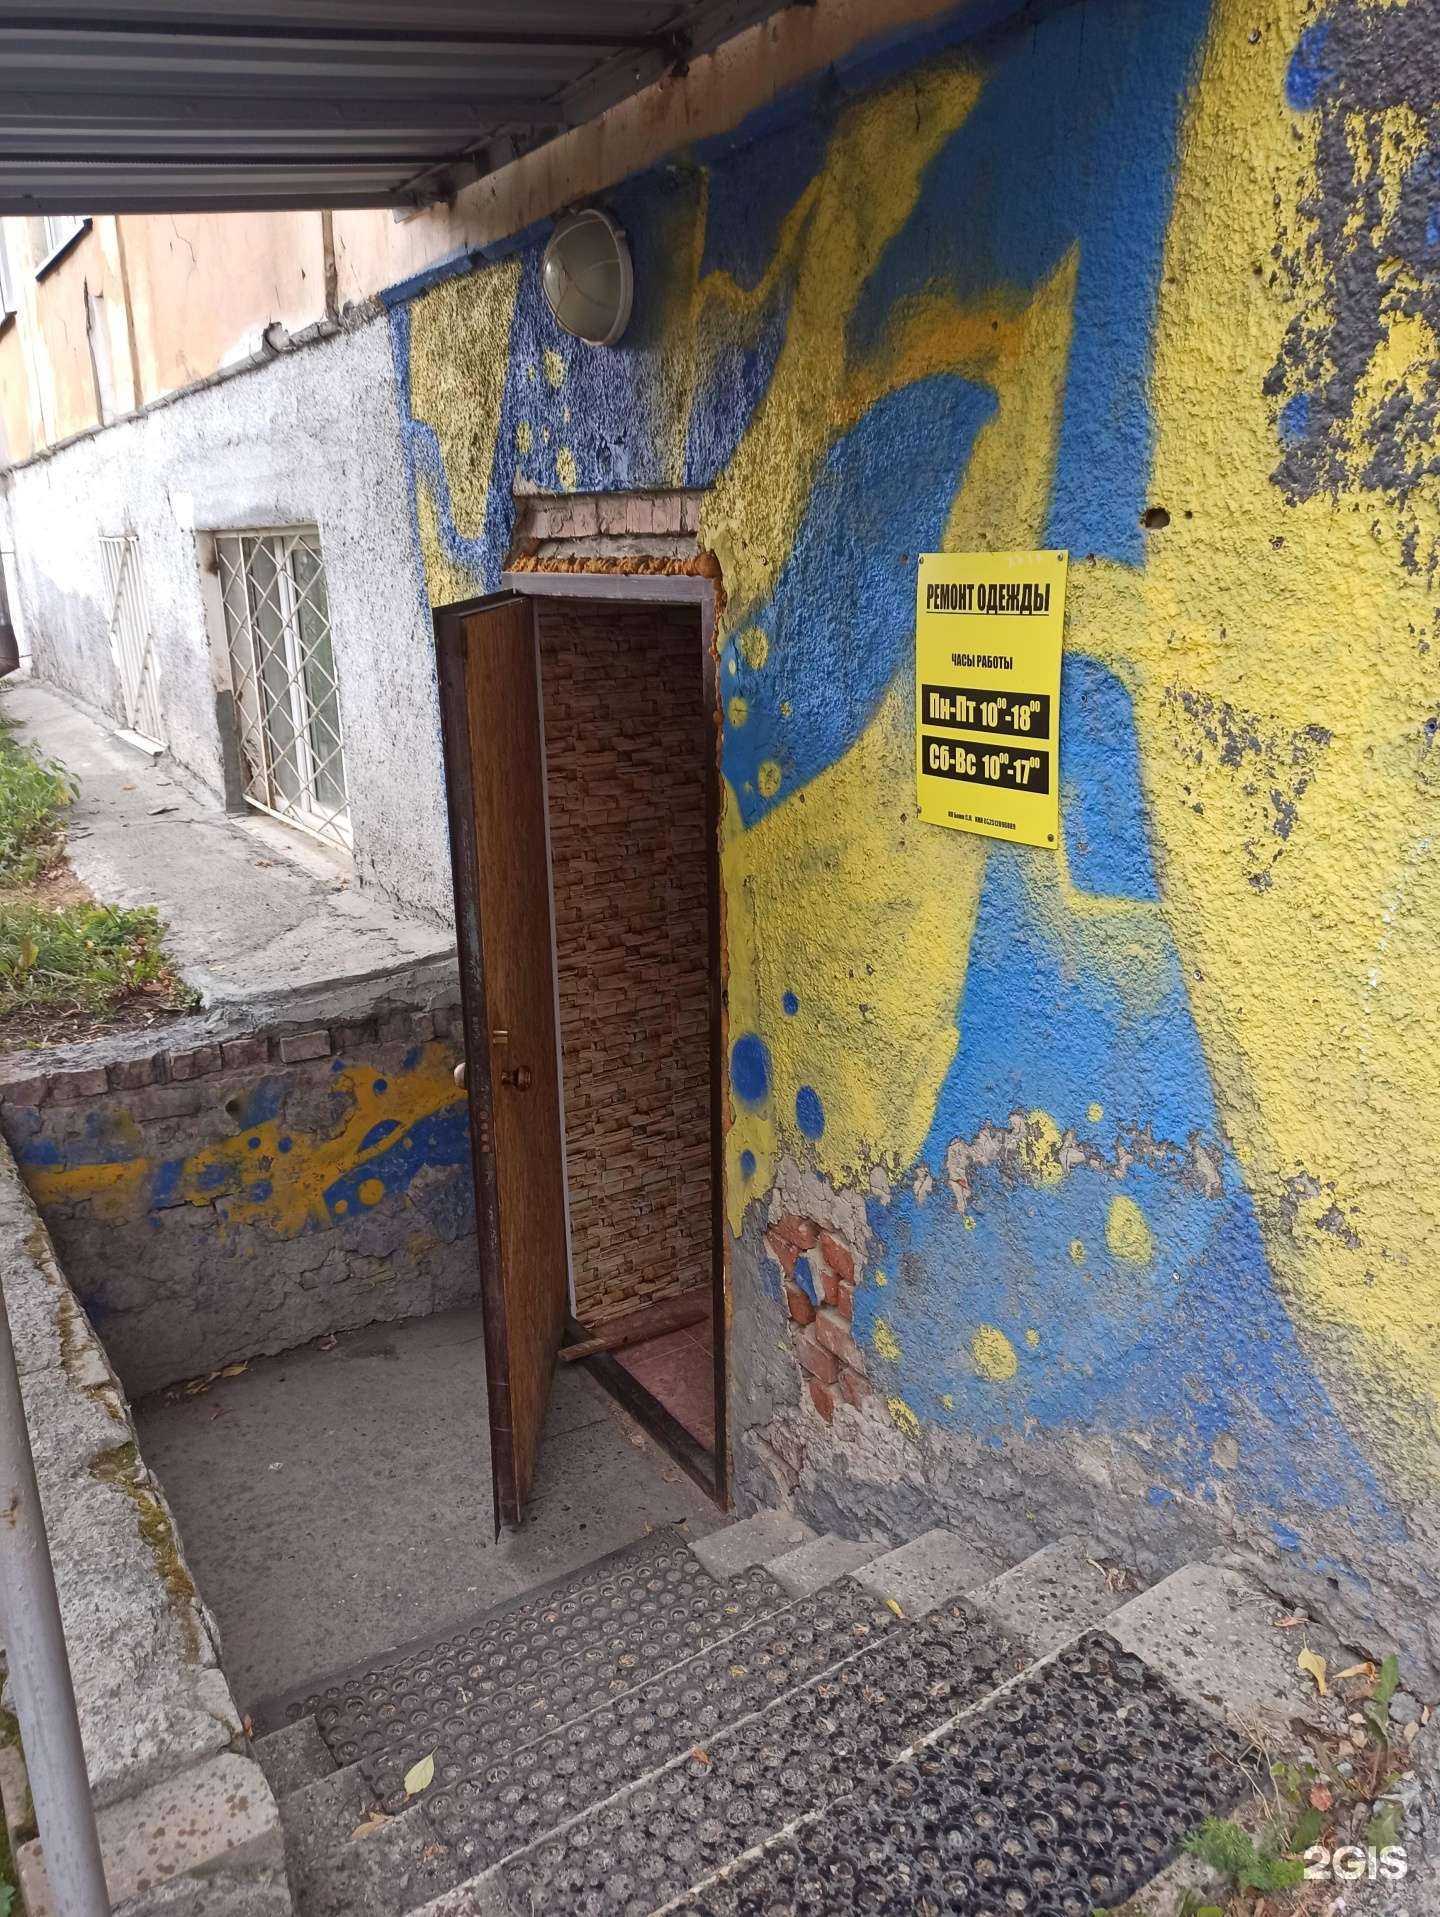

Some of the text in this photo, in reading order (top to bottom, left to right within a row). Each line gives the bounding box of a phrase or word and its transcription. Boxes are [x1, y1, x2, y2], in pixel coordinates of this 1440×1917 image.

[926, 583, 1051, 615] РЕМОНТ ОДЕЖДЫ
[951, 653, 1014, 670] ЧАСЫ РАБОТЫ
[929, 692, 977, 723] Пн-Пт
[929, 743, 977, 776] Сб-Вс
